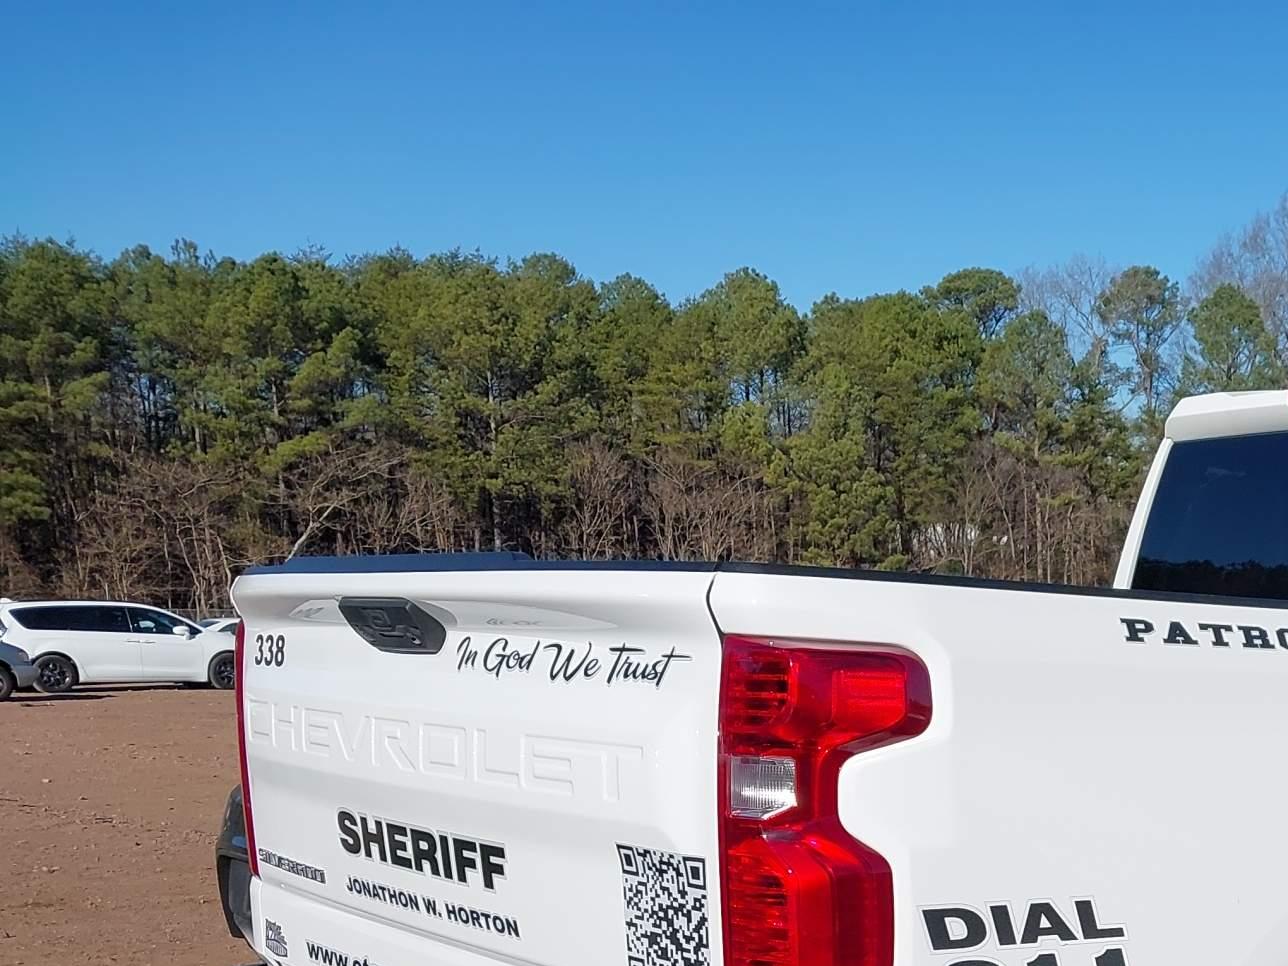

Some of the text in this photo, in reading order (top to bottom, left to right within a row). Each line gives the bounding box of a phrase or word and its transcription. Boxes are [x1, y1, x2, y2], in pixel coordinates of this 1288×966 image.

[254, 634, 286, 667] 338
[456, 636, 693, 687] In God We Trust
[248, 700, 645, 800] CHEVROLET
[337, 809, 506, 891] SHERIFF
[345, 876, 520, 938] JONATHON W. HORTON
[921, 899, 1127, 952] DIAL
